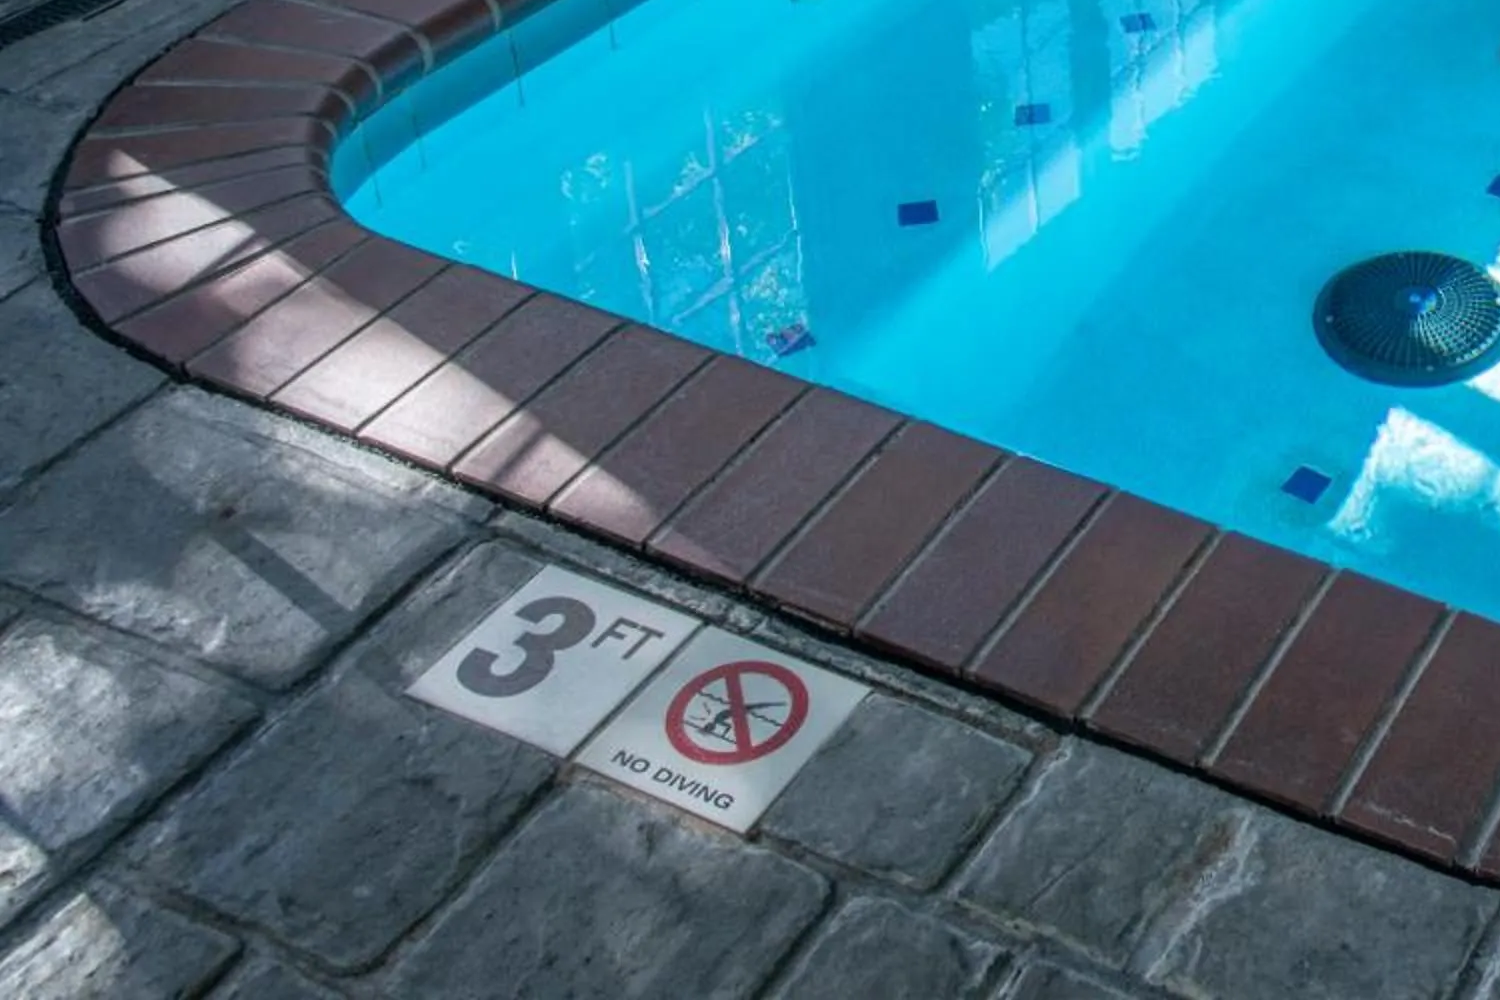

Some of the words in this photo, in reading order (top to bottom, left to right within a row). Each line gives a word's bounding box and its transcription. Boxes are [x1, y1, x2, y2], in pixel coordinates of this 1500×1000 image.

[456, 596, 596, 698] 3
[591, 617, 664, 661] FT
[611, 749, 650, 774] NO
[653, 767, 736, 811] DIVING
